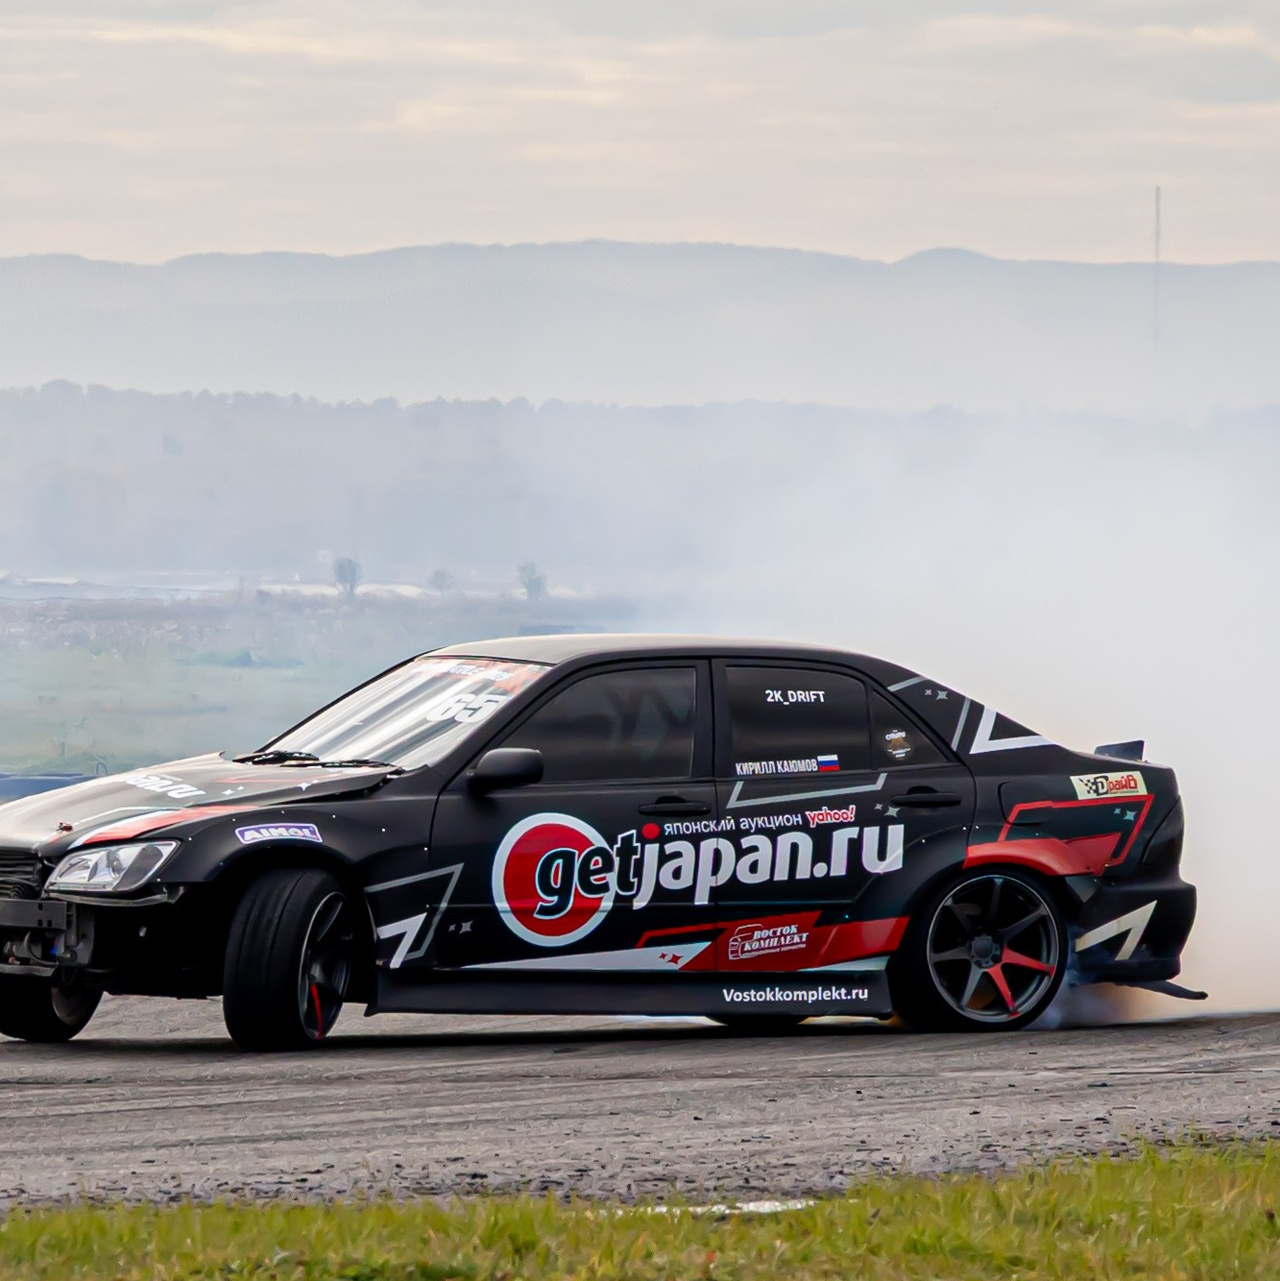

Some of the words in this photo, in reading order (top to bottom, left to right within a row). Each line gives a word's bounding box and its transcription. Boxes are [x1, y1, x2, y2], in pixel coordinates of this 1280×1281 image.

[765, 690, 825, 705] 2K_DRIFT
[426, 693, 507, 723] 65
[735, 761, 776, 776] КИРИЛЛ
[777, 758, 818, 773] КАЮМОВ
[664, 816, 736, 836] японский
[740, 812, 803, 833] аукцион
[805, 804, 856, 828] yahoo!
[752, 924, 799, 940] ВОСТОК
[743, 932, 810, 952] КОМПЛЕКТ
[723, 986, 868, 1003] Vostokkomplekt.ru
